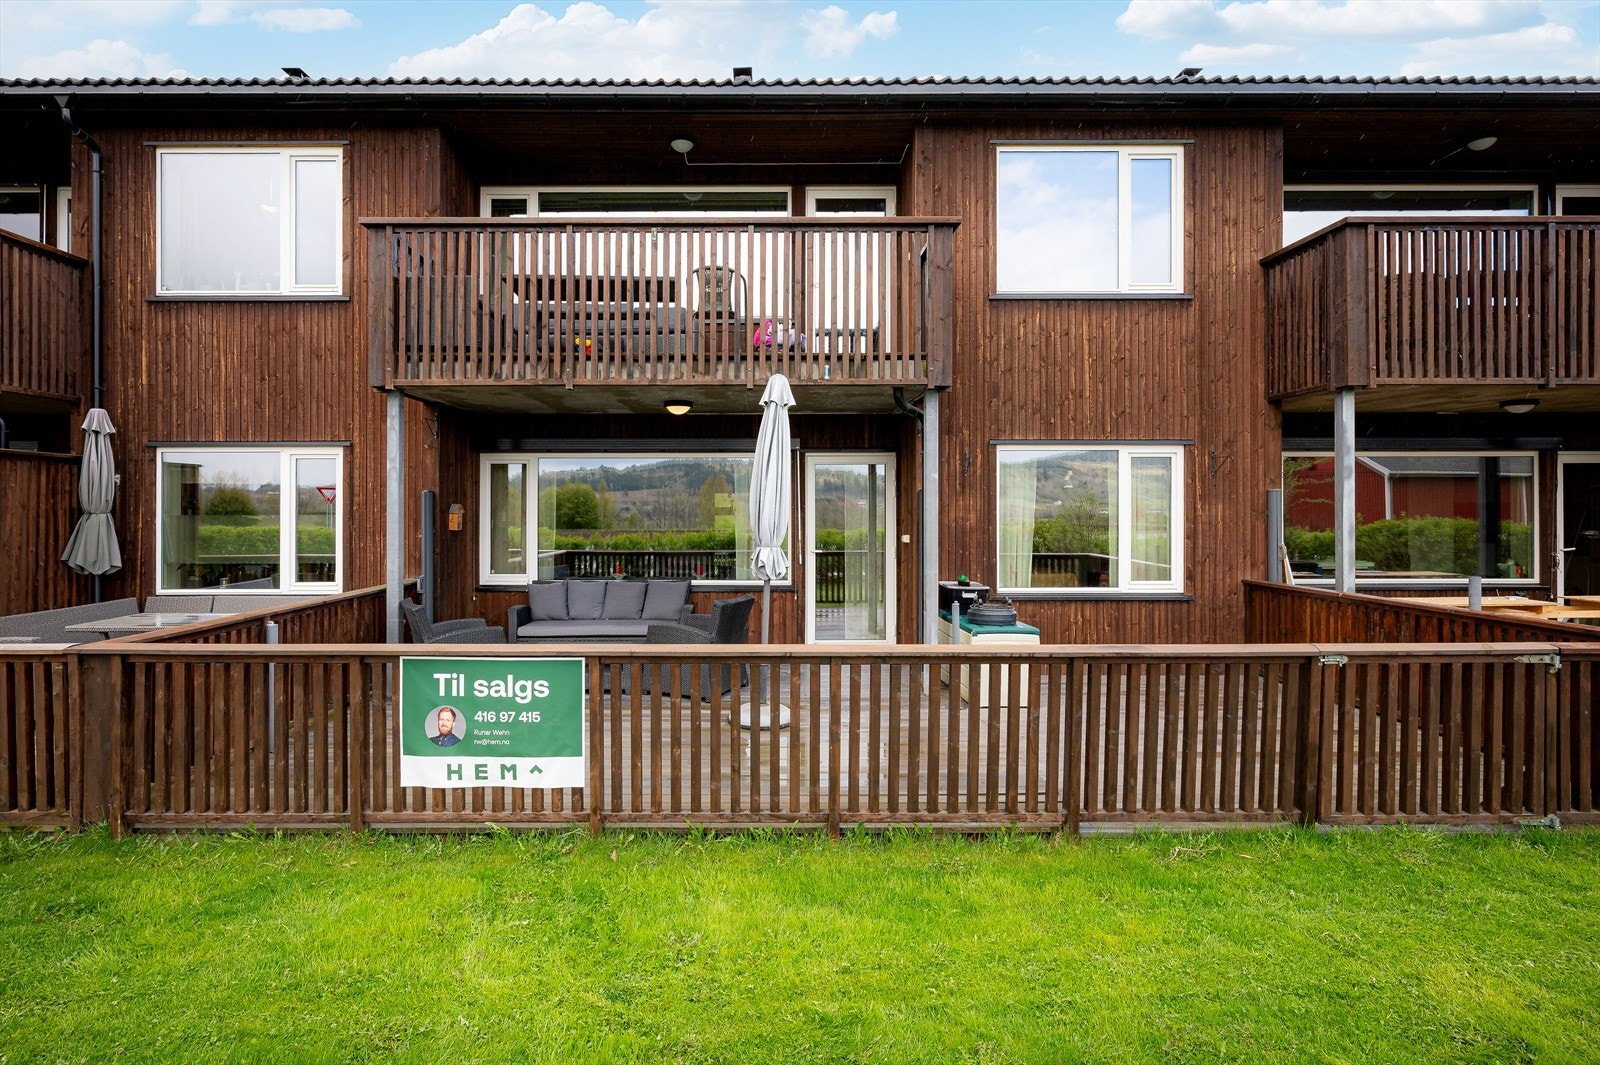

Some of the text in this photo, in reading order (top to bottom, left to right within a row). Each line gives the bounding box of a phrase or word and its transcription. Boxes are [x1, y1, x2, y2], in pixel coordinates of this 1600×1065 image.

[433, 673, 550, 704] Til salgs
[474, 711, 541, 723] 416 97 415
[446, 763, 517, 781] HEM
